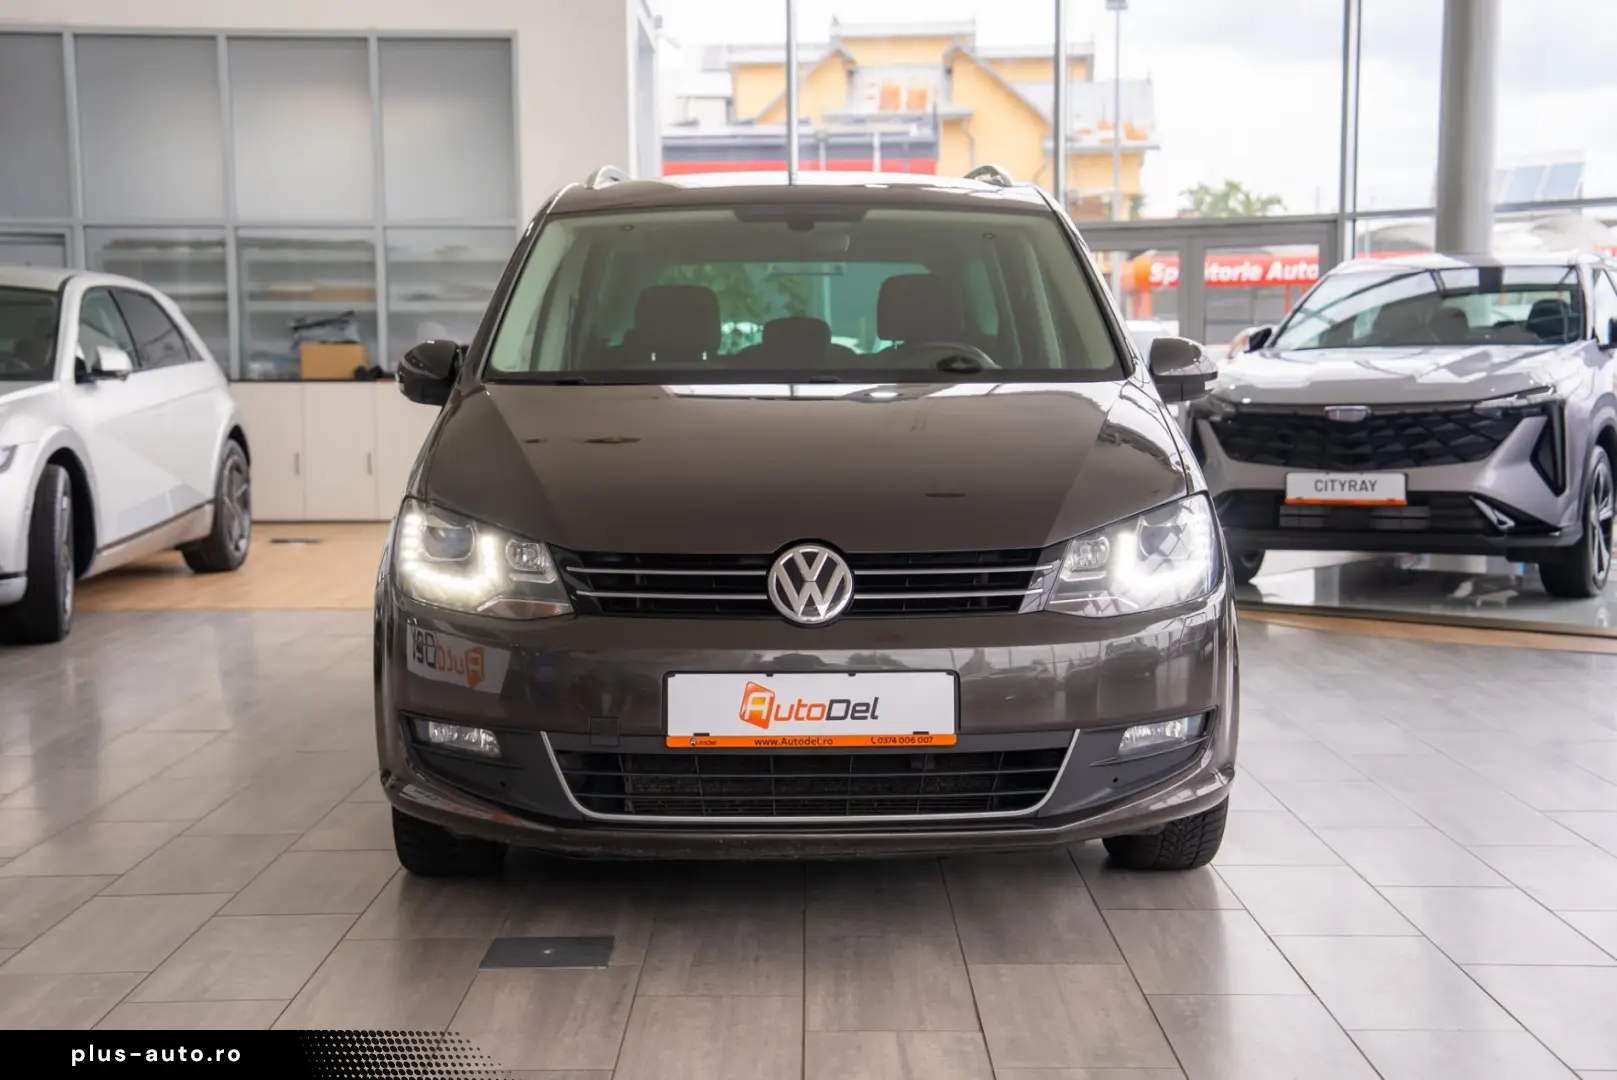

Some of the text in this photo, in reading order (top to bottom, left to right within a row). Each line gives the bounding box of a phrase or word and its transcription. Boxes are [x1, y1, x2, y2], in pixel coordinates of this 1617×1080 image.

[1150, 261, 1319, 284] Sptorie Auto
[1314, 479, 1378, 492] CITYRAY
[740, 681, 880, 729] AutoDel
[754, 737, 834, 746] www.Autodel.ro
[878, 736, 897, 744] 0374
[918, 736, 934, 744] 007
